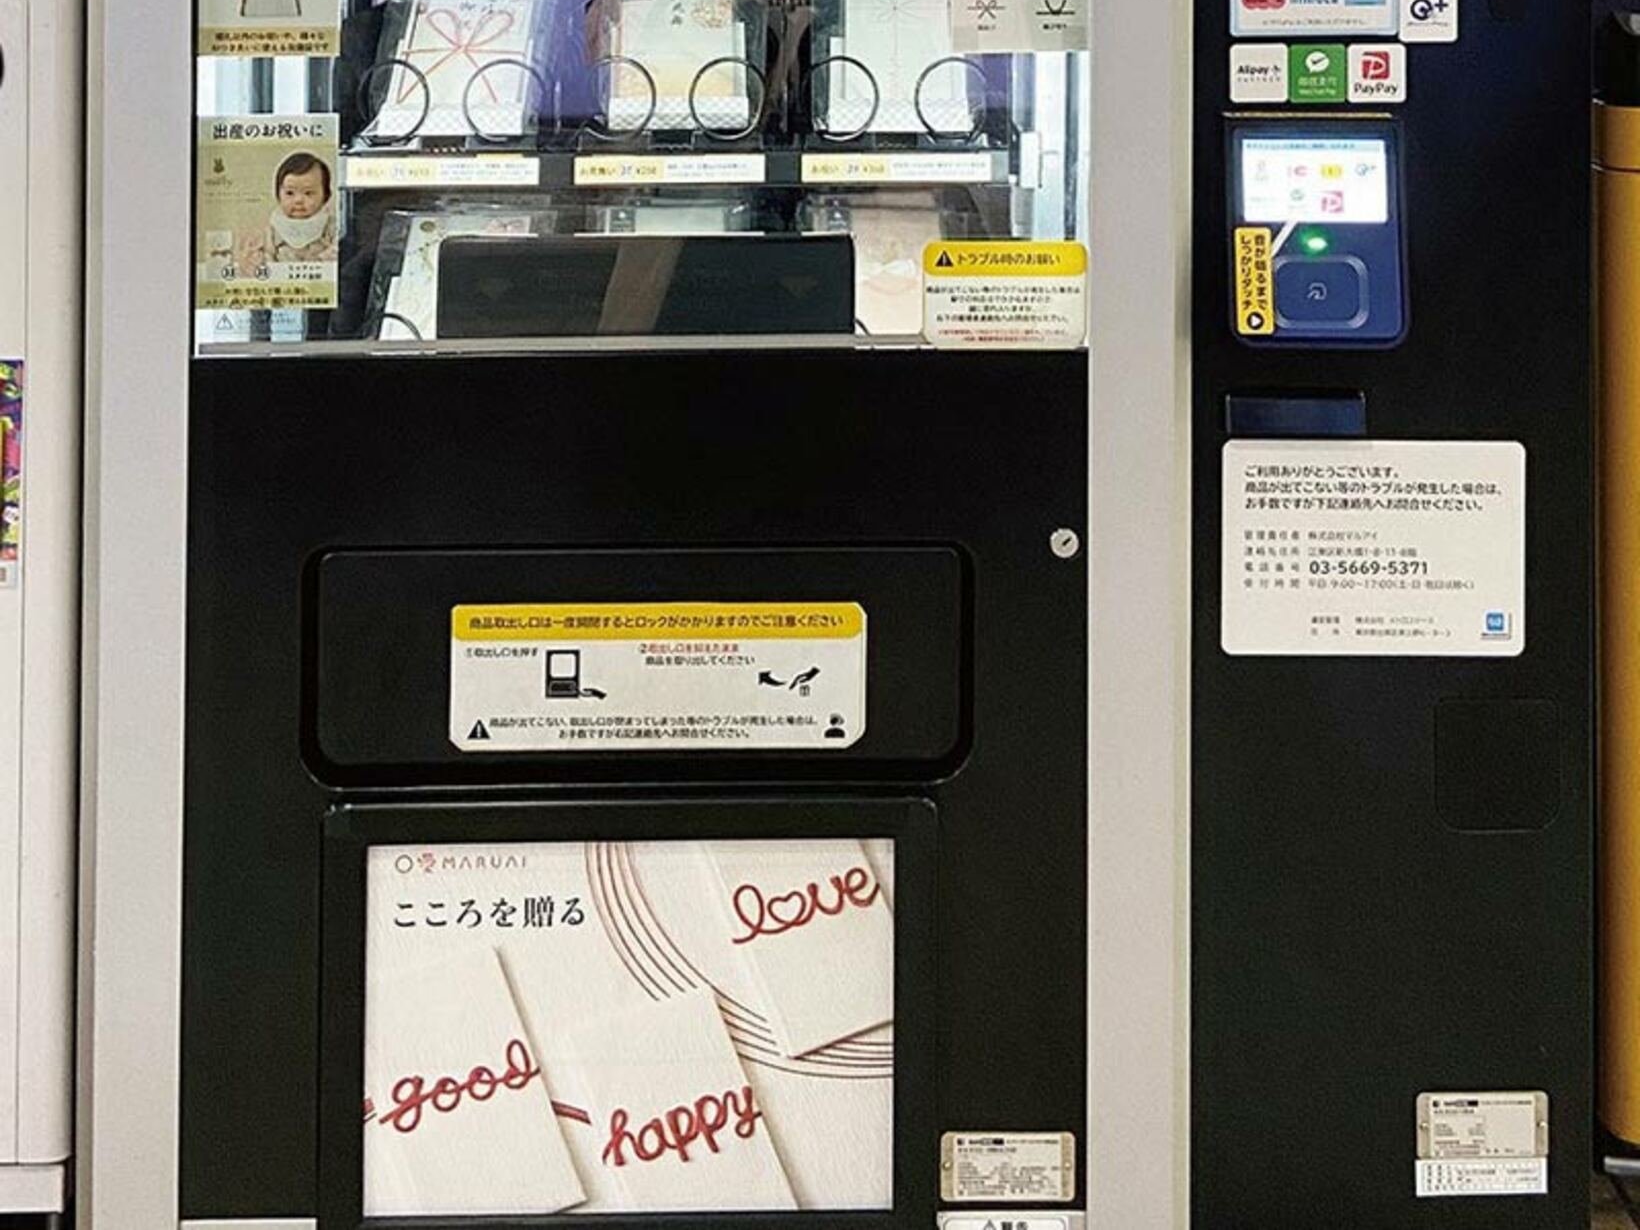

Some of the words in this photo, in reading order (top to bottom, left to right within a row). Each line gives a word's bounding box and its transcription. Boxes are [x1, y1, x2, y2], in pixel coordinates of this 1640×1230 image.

[1354, 83, 1398, 96] PayPay
[213, 123, 324, 140] 出産のお祝いに
[957, 253, 1061, 266] トラブル時のお願い
[1244, 465, 1400, 478] ご利用ありがとうございます。
[1309, 561, 1428, 575] 03-5669-5371
[442, 854, 526, 870] MARUAI
[393, 896, 586, 929] こころを贈る
[732, 866, 880, 944] love
[379, 1039, 540, 1133] good
[602, 1085, 762, 1167] happy
